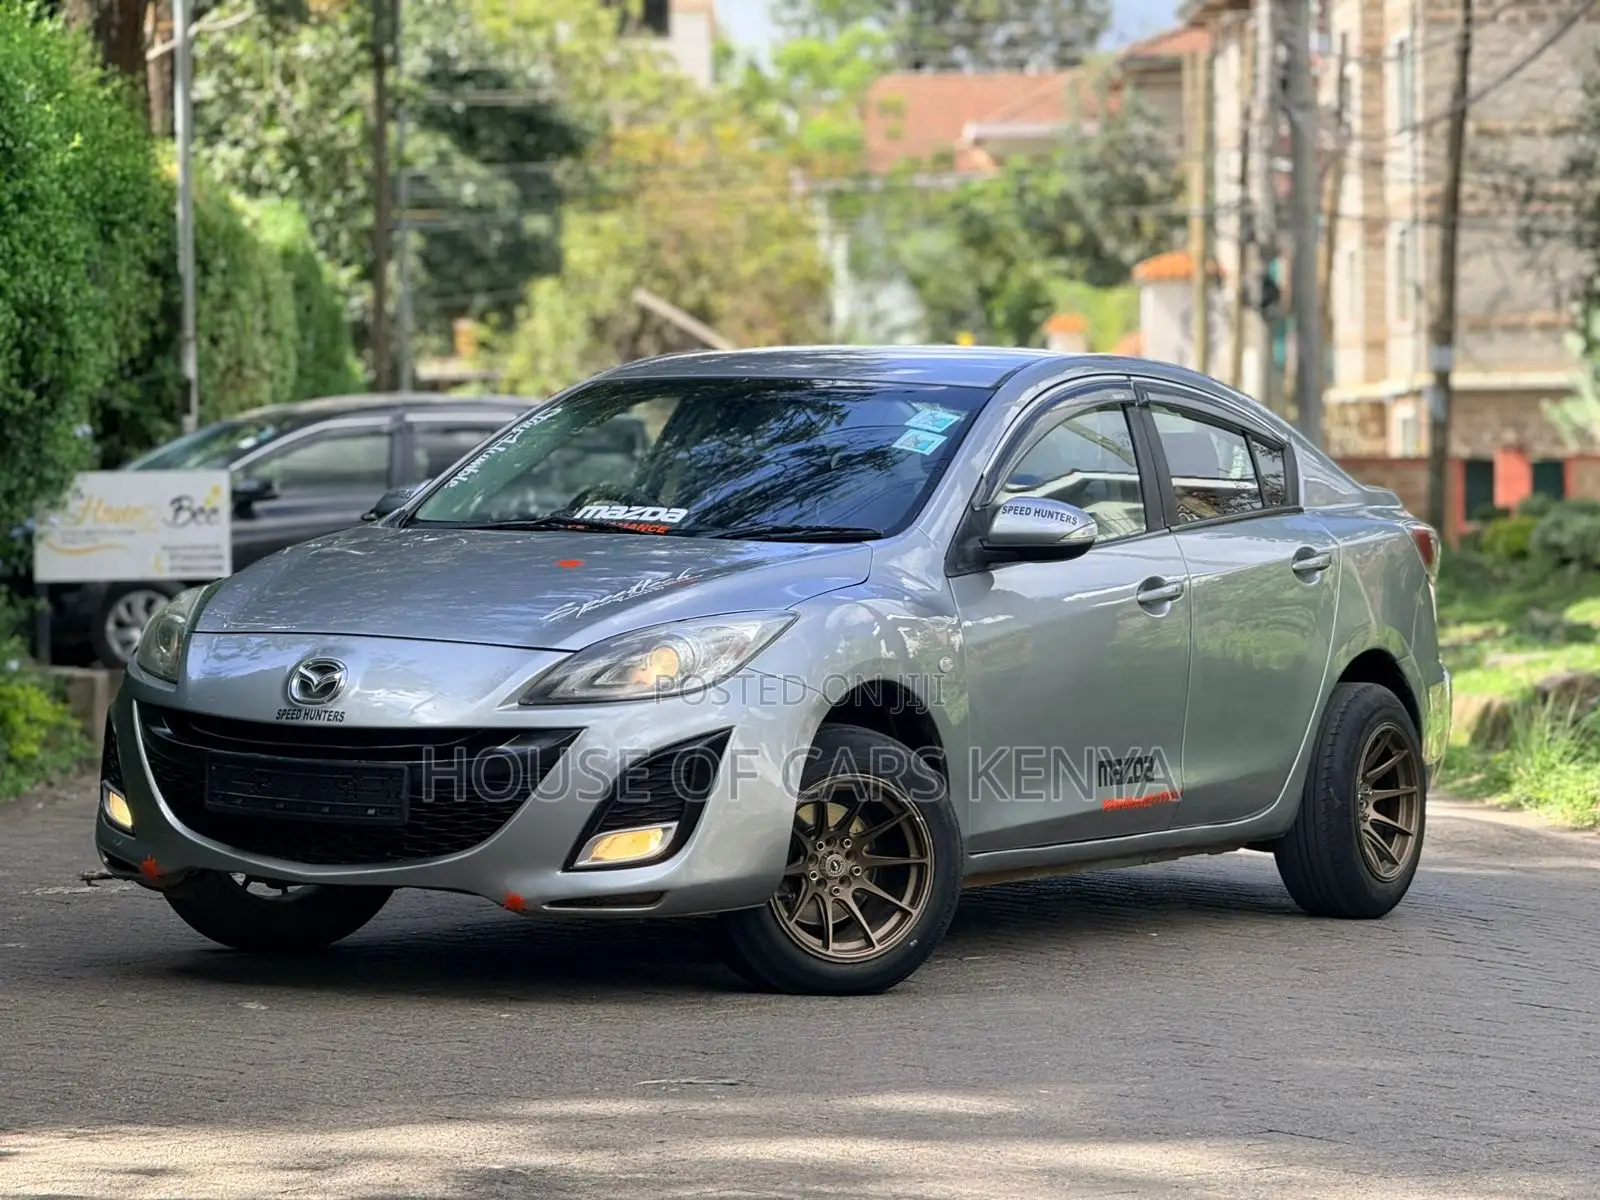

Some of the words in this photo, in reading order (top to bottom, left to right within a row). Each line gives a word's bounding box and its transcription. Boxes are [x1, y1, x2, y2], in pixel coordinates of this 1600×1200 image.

[161, 494, 220, 529] Bee
[573, 505, 689, 523] mazda
[1001, 505, 1031, 516] SPEED
[1033, 507, 1078, 526] HUNTERS
[276, 708, 302, 720] SPEED
[303, 708, 346, 722] HUNTERS
